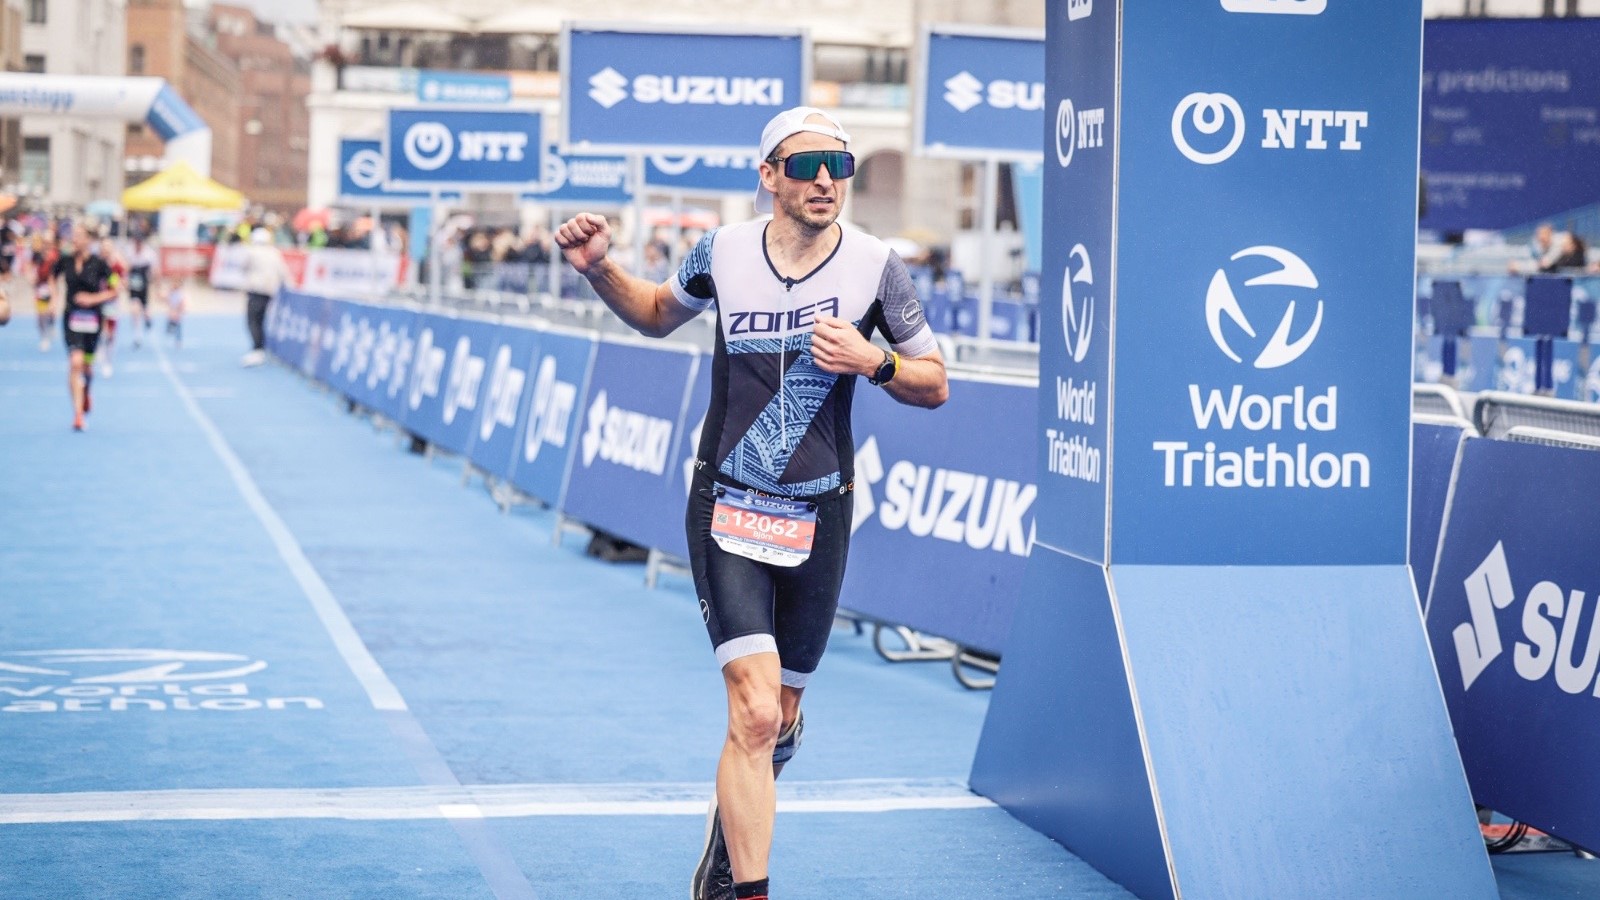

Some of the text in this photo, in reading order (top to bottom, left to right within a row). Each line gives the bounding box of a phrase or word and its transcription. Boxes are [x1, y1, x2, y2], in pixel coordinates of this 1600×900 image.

[632, 74, 784, 105] SUZUKI
[457, 131, 528, 161] NTT
[1077, 108, 1104, 149] NTT
[1261, 109, 1368, 150] NTT
[1056, 376, 1095, 425] World
[1188, 384, 1337, 431] World
[600, 406, 673, 476] SUZUKI
[1046, 428, 1100, 483] Triathlon
[1153, 441, 1370, 488] Triathlon
[732, 511, 798, 539] 12062
[754, 499, 796, 511] SUZUKI
[752, 530, 774, 541] Björn
